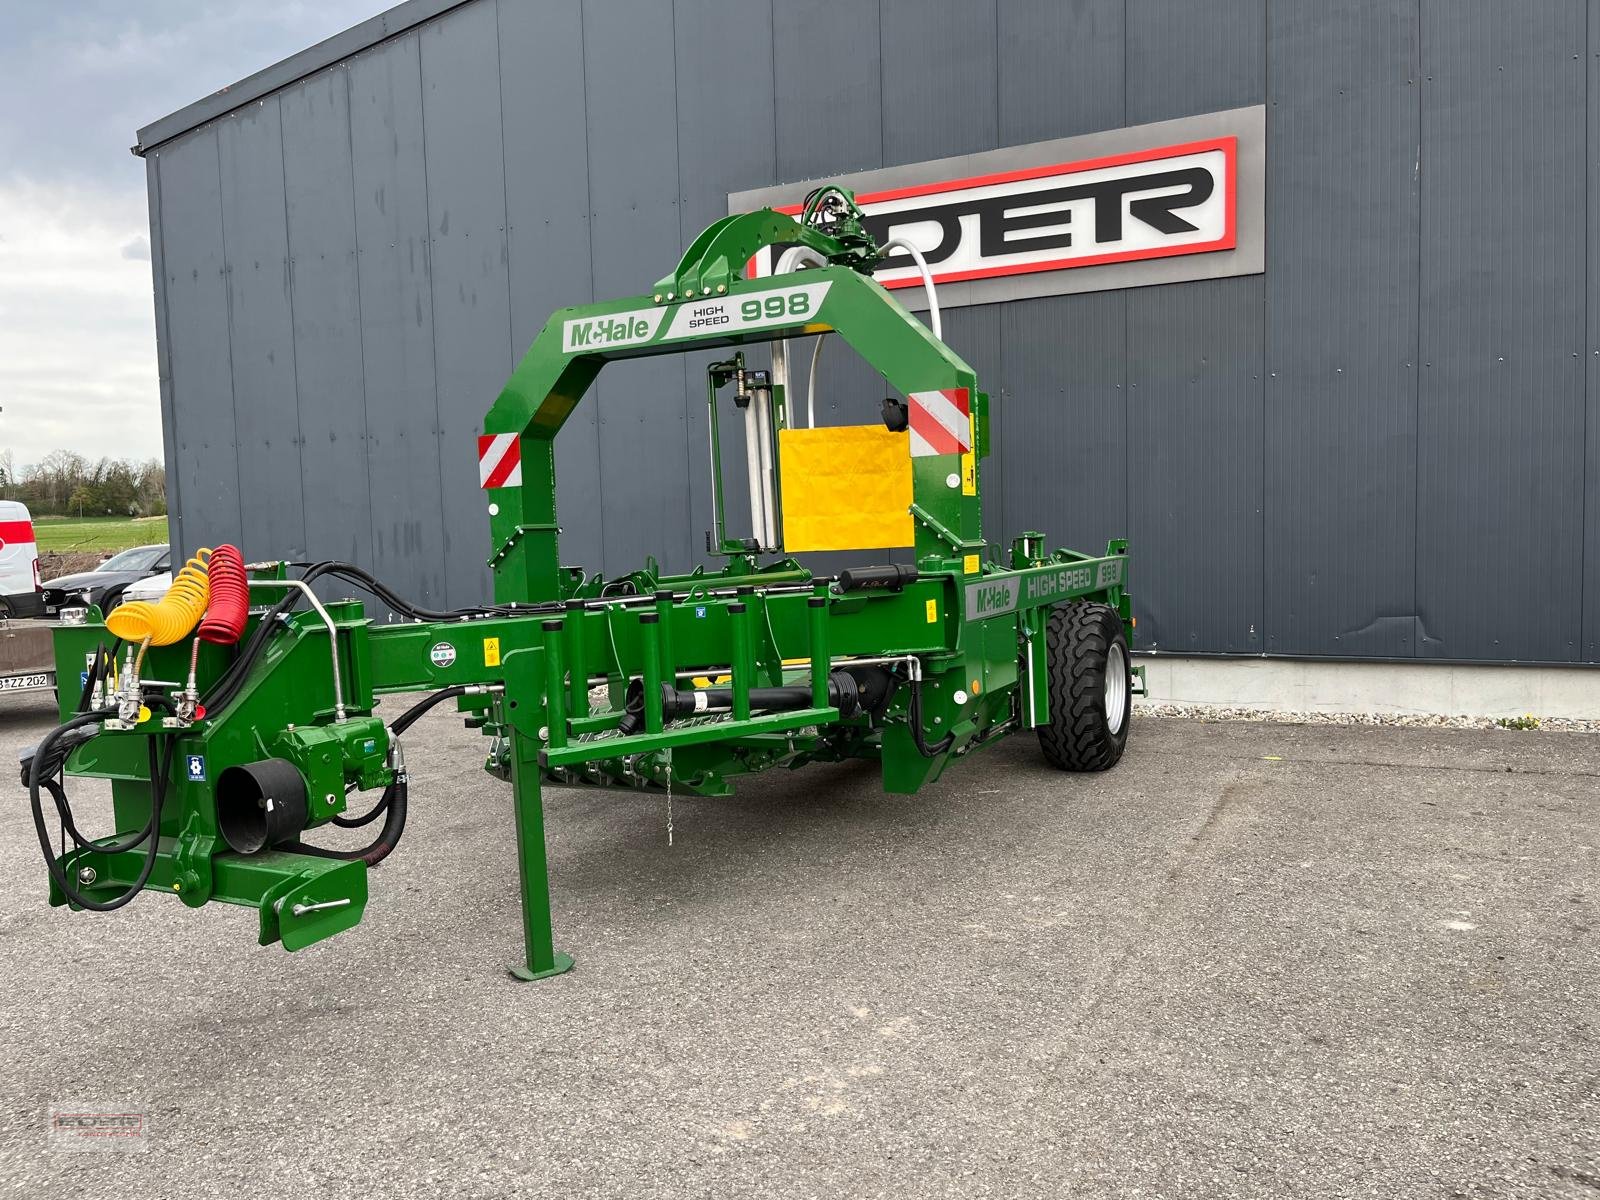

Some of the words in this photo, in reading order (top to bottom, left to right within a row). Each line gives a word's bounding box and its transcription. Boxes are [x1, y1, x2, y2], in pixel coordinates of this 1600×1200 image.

[770, 166, 1214, 278] DER
[693, 306, 724, 317] HIGH
[741, 292, 809, 321] 998
[571, 316, 648, 346] McHale
[689, 315, 729, 328] SPEED
[1027, 573, 1057, 598] HIGH
[1059, 568, 1091, 592] SPEED
[10, 678, 25, 688] ZZ
[26, 675, 46, 687] 202
